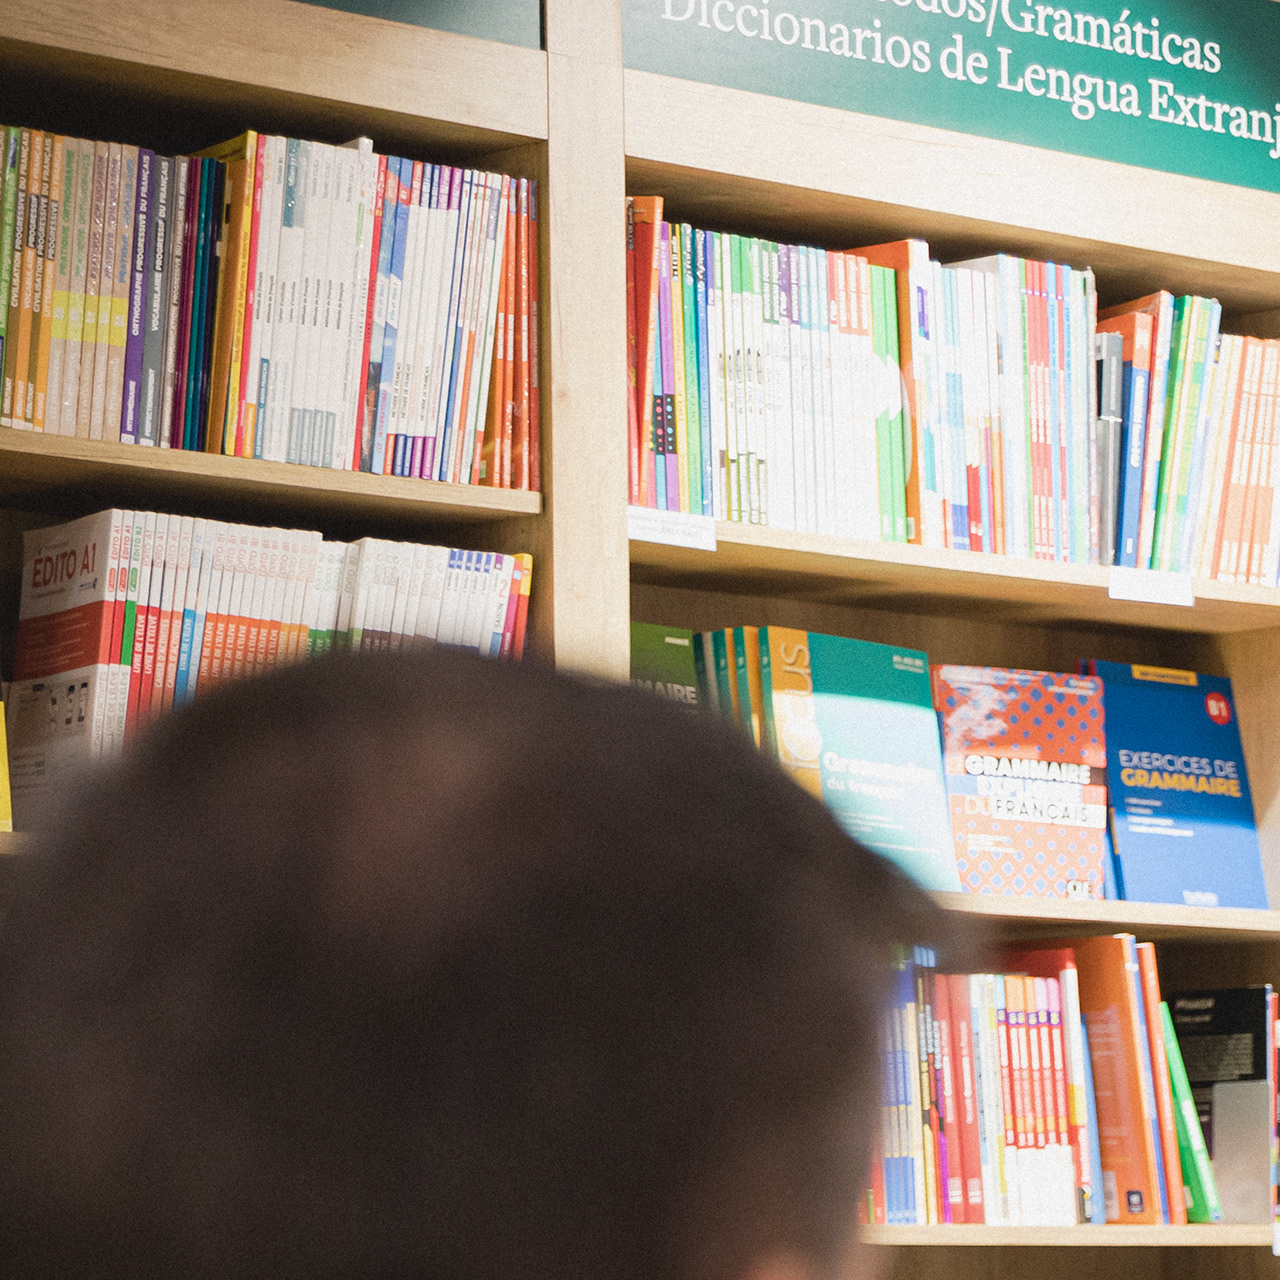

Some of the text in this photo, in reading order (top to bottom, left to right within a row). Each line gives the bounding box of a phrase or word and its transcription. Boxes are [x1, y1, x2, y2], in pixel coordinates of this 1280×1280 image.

[660, 0, 932, 73] Diccionarios
[939, 34, 989, 84] de
[997, 47, 1142, 121] Lengua
[15, 190, 27, 251] PROGRESSIVE
[27, 194, 39, 248] PROGRESSIF
[37, 196, 49, 257] PROGRESSIVE
[47, 200, 59, 260] PROGRESSIVE
[139, 199, 148, 212] DU
[135, 213, 147, 272] PROGRESSIVE
[155, 219, 166, 271] PROGRESSIF
[10, 250, 22, 308] CIVILISATION
[23, 249, 35, 309] VOCABULAIRE
[33, 257, 45, 313] CIVILISATION
[131, 272, 144, 336] ORTHOGRAPHE
[151, 272, 163, 331] VOCABULAIRE
[80, 543, 97, 575] A1
[132, 653, 142, 674] LIVRE
[1207, 698, 1228, 718] B1
[965, 755, 1091, 785] GRAMMAIRE
[1119, 750, 1238, 779] EXERCICES DE
[1120, 768, 1242, 798] GRAMMAIRE
